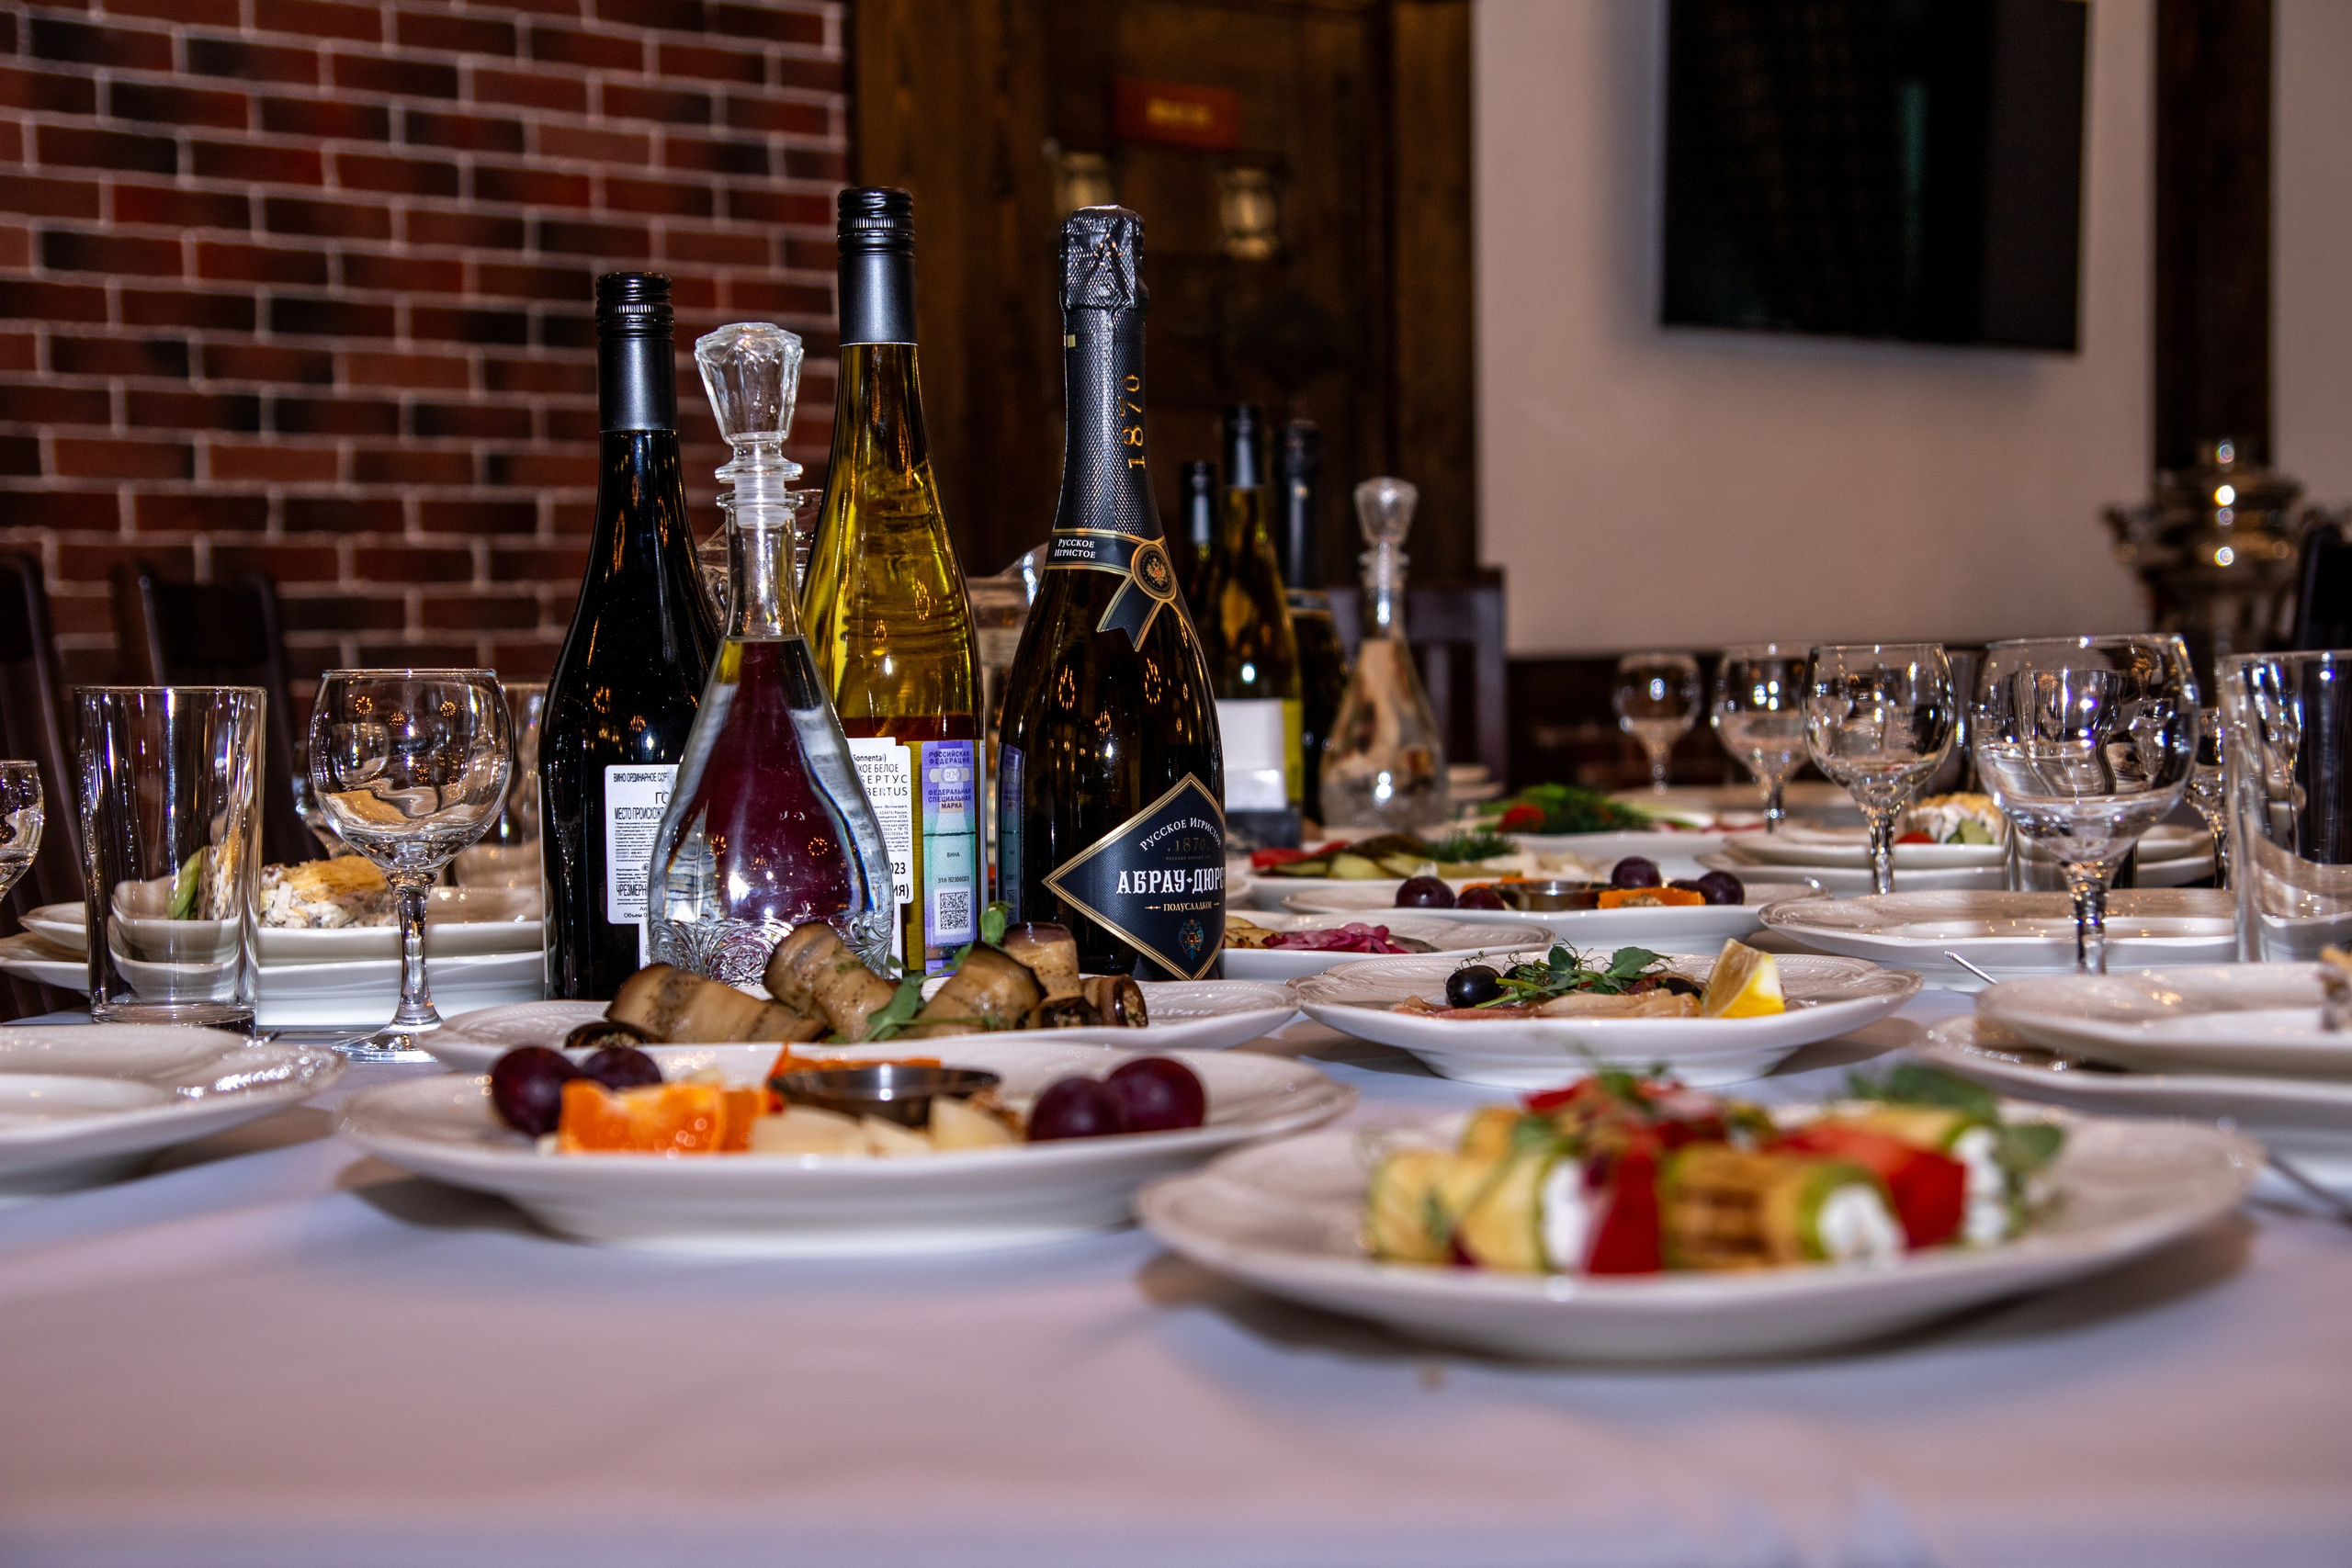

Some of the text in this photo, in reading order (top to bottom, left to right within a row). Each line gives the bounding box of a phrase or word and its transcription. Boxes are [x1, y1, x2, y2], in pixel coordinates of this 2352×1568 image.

[1117, 374, 1146, 469] 1870
[1057, 538, 1094, 548] РУССКОЕ
[1054, 548, 1096, 558] ИГРИСТОЕ
[929, 750, 970, 758] РОССИЙСКАЯ
[929, 757, 970, 765] ФЕДЕРАЦИЯ
[874, 763, 899, 773] БЕЛОЕ
[614, 773, 626, 783] ВИНО
[627, 773, 657, 783] ОРДИНАРНОЕ
[928, 787, 971, 795] ФЕДЕРАЛЬНАЯ
[928, 795, 971, 803] СПЕЦИАЛЬНАЯ
[615, 807, 631, 819] МЕСТО
[1139, 819, 1187, 852] РУССКОЕ
[616, 884, 648, 897] ЧРЕЗМЕРН
[1163, 901, 1212, 912] ПОЛУСЛАДКОЕ
